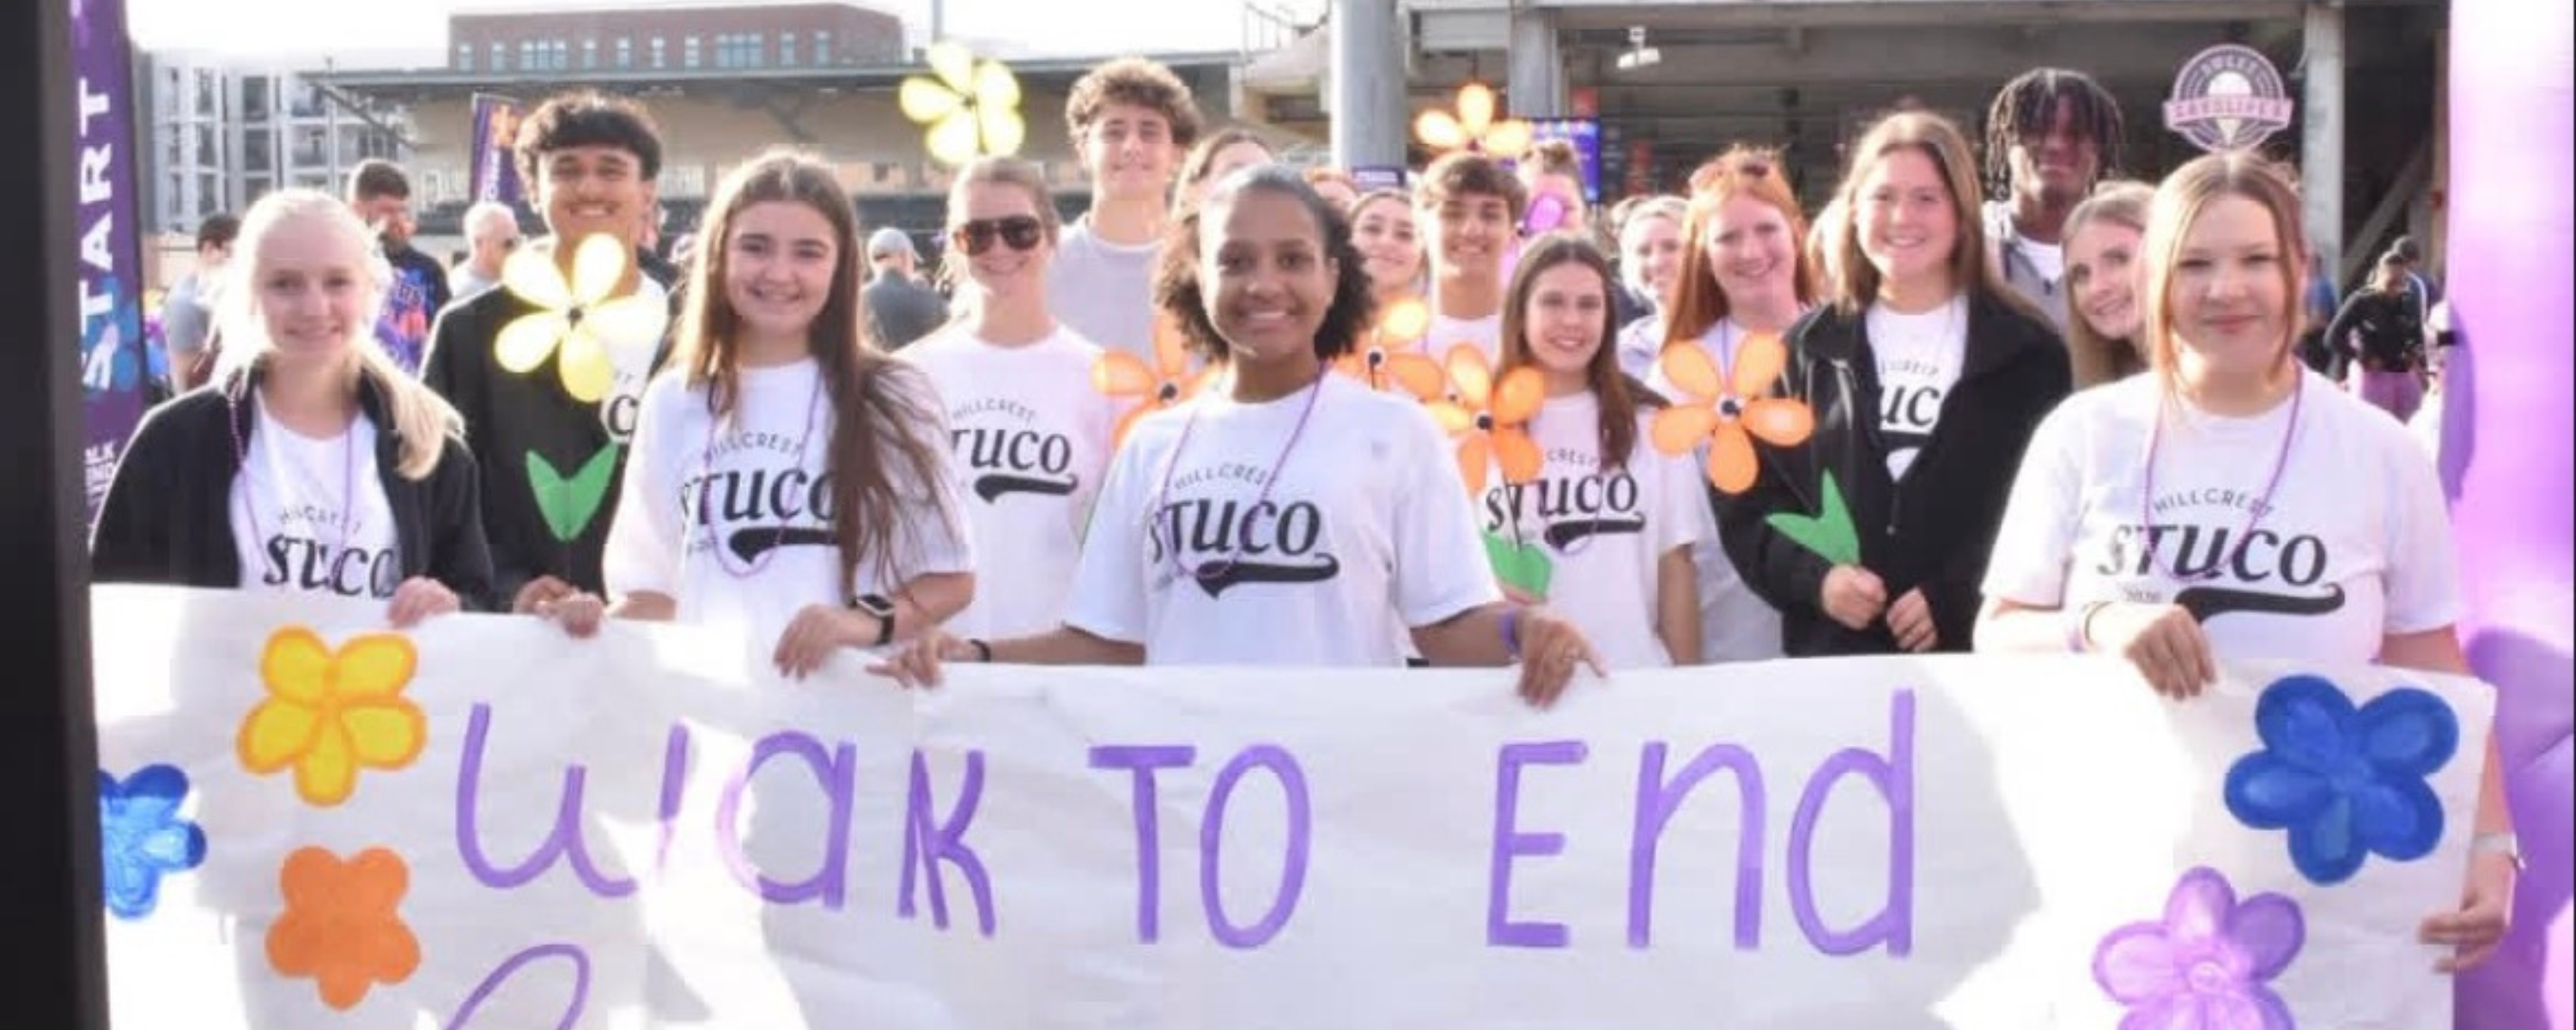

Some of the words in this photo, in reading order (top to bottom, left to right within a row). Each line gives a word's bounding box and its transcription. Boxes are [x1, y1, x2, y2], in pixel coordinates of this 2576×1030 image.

[79, 77, 120, 391] START
[950, 428, 1072, 475] TUCO
[1175, 462, 1268, 490] HILLCRES
[2097, 525, 2327, 587] STUCO
[1087, 742, 1311, 949] TO
[1487, 688, 1916, 957] End
